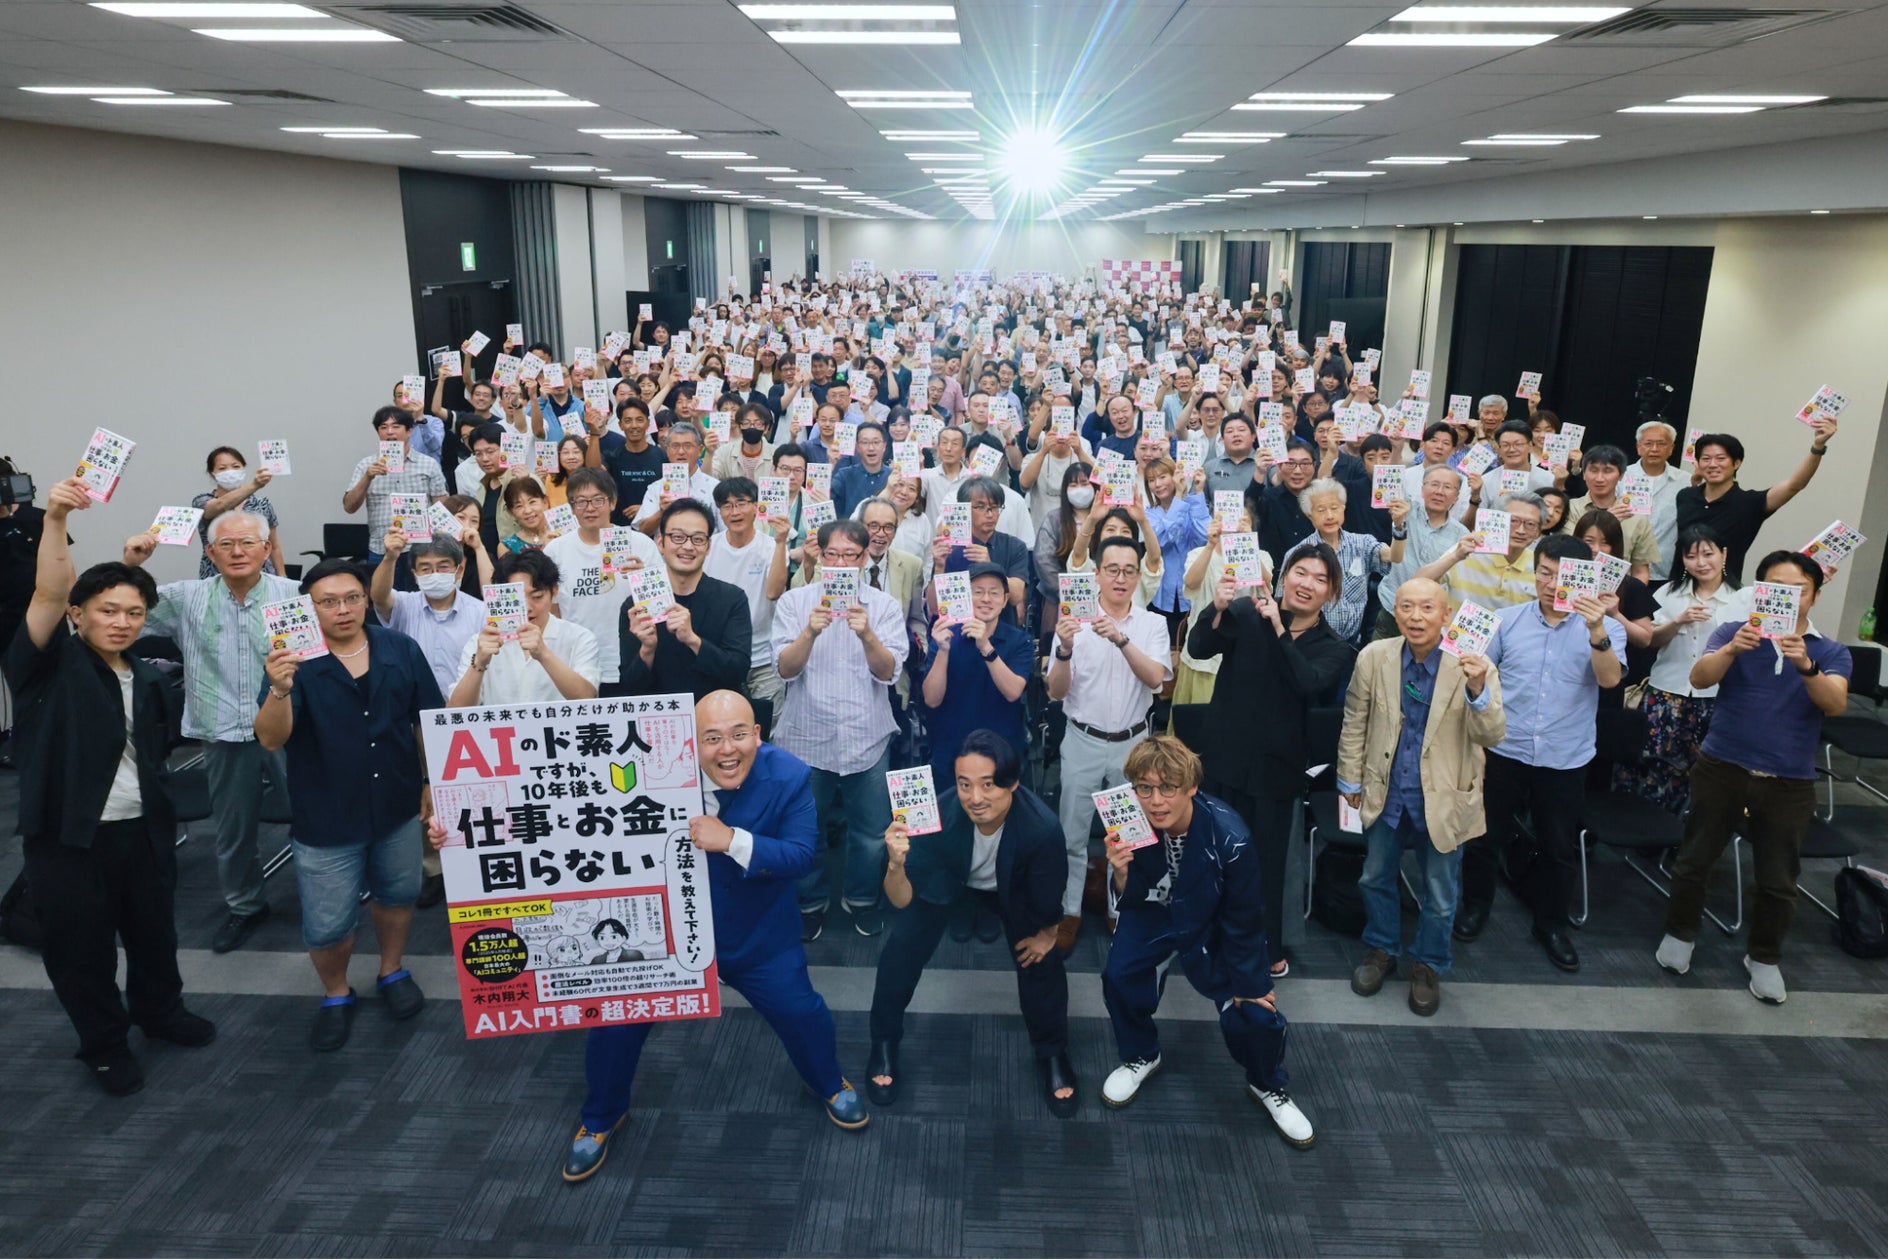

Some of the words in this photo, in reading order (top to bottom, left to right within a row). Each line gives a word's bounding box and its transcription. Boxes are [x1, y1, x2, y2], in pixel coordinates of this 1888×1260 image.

[581, 567, 600, 577] THE
[572, 586, 600, 597] FACE
[577, 577, 600, 588] DOG
[434, 700, 680, 725] 最悪の未来でも自分だけが助かる本
[442, 720, 652, 781] AIのド素人
[530, 762, 597, 779] ですが、
[521, 782, 608, 801] 10年後も
[458, 795, 687, 849] 仕事とお金に
[479, 850, 655, 893] 困らない
[459, 904, 546, 918] コレ1冊ですべてOK
